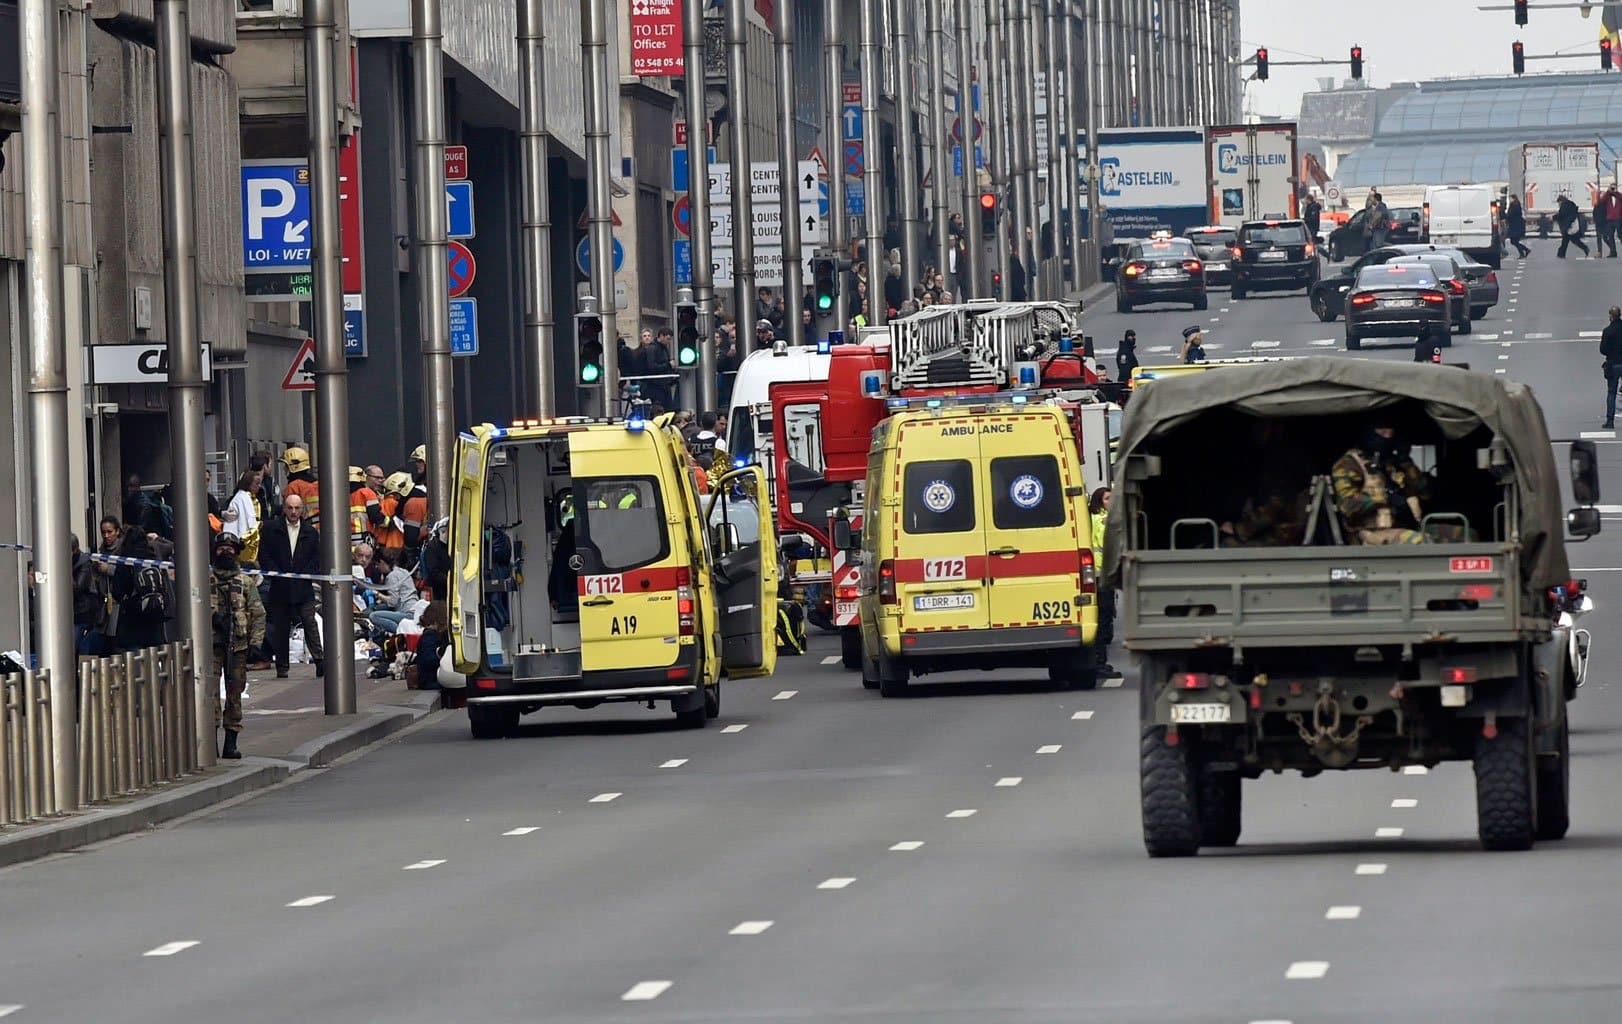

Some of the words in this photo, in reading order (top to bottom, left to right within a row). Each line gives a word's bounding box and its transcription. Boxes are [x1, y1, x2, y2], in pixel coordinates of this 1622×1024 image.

[650, 6, 671, 15] Frank
[633, 24, 652, 36] TO
[654, 24, 676, 36] LET
[633, 39, 667, 49] Offices
[634, 58, 645, 67] 02
[663, 57, 674, 66] 05
[445, 152, 465, 161] OUGE
[753, 170, 780, 180] CENTR
[1099, 157, 1173, 196] CASTELEIN
[751, 184, 780, 194] CENTR
[246, 178, 297, 240] P
[752, 212, 781, 223] LOUIS
[752, 226, 781, 237] LOUIZ
[248, 249, 270, 261] LOI
[290, 274, 312, 285] LIBR
[934, 560, 964, 577] 112
[595, 576, 621, 594] 112
[1032, 600, 1071, 620] AS29
